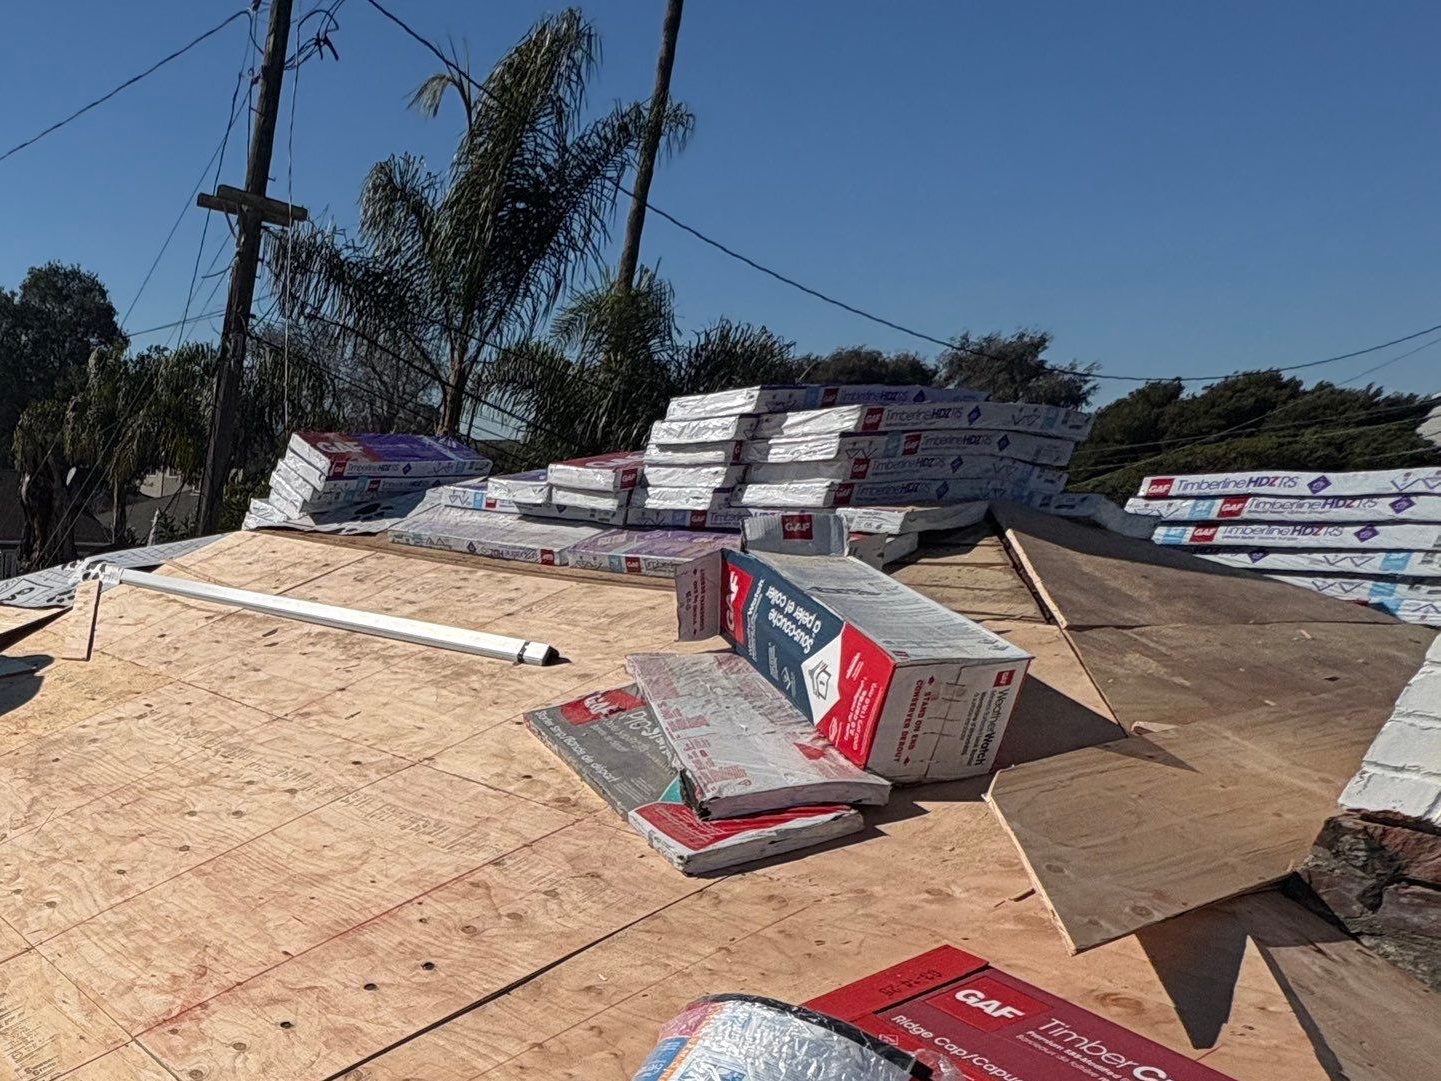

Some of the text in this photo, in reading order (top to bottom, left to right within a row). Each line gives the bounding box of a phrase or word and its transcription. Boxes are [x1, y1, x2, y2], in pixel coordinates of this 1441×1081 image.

[866, 415, 881, 423] GAF
[622, 473, 636, 483] GAF
[1148, 484, 1170, 493] GAF
[1220, 503, 1244, 512] GAF
[692, 515, 705, 523] GAF
[784, 522, 809, 532] GAF
[1194, 527, 1216, 536] GAF
[627, 561, 640, 569] GAF
[726, 572, 739, 631] GAF
[765, 585, 787, 606] coller
[793, 605, 815, 629] peler
[768, 608, 814, 654] Sous-couche
[909, 691, 932, 751] STAND ON END
[975, 688, 1009, 766] WeatherWatch
[894, 731, 909, 762] DEBOUT
[954, 989, 1026, 1020] GAF
[891, 1015, 934, 1040] Ridge
